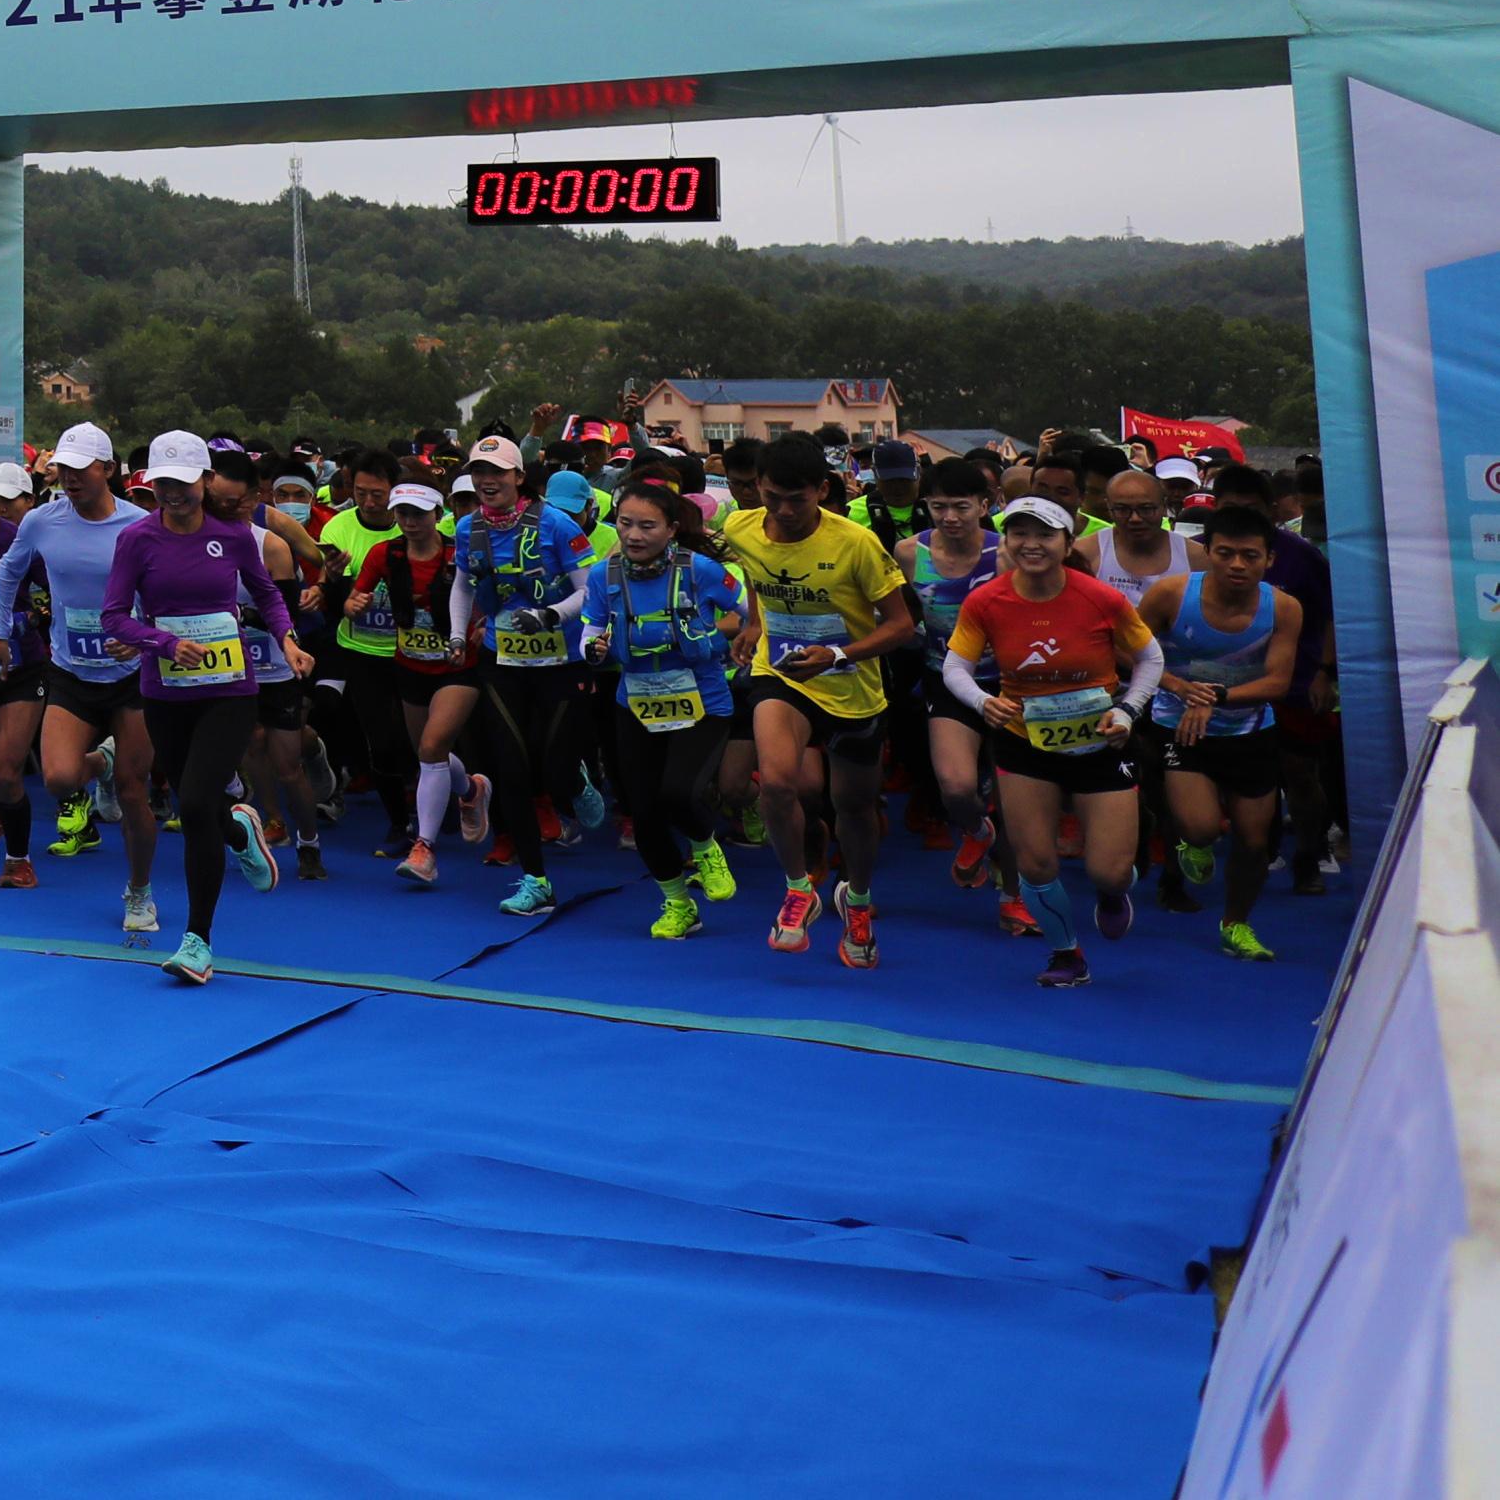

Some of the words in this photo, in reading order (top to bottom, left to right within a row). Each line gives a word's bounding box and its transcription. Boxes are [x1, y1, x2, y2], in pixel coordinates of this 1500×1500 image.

[474, 166, 700, 216] 00:00:00
[502, 636, 558, 656] 2204
[637, 698, 694, 719] 2279
